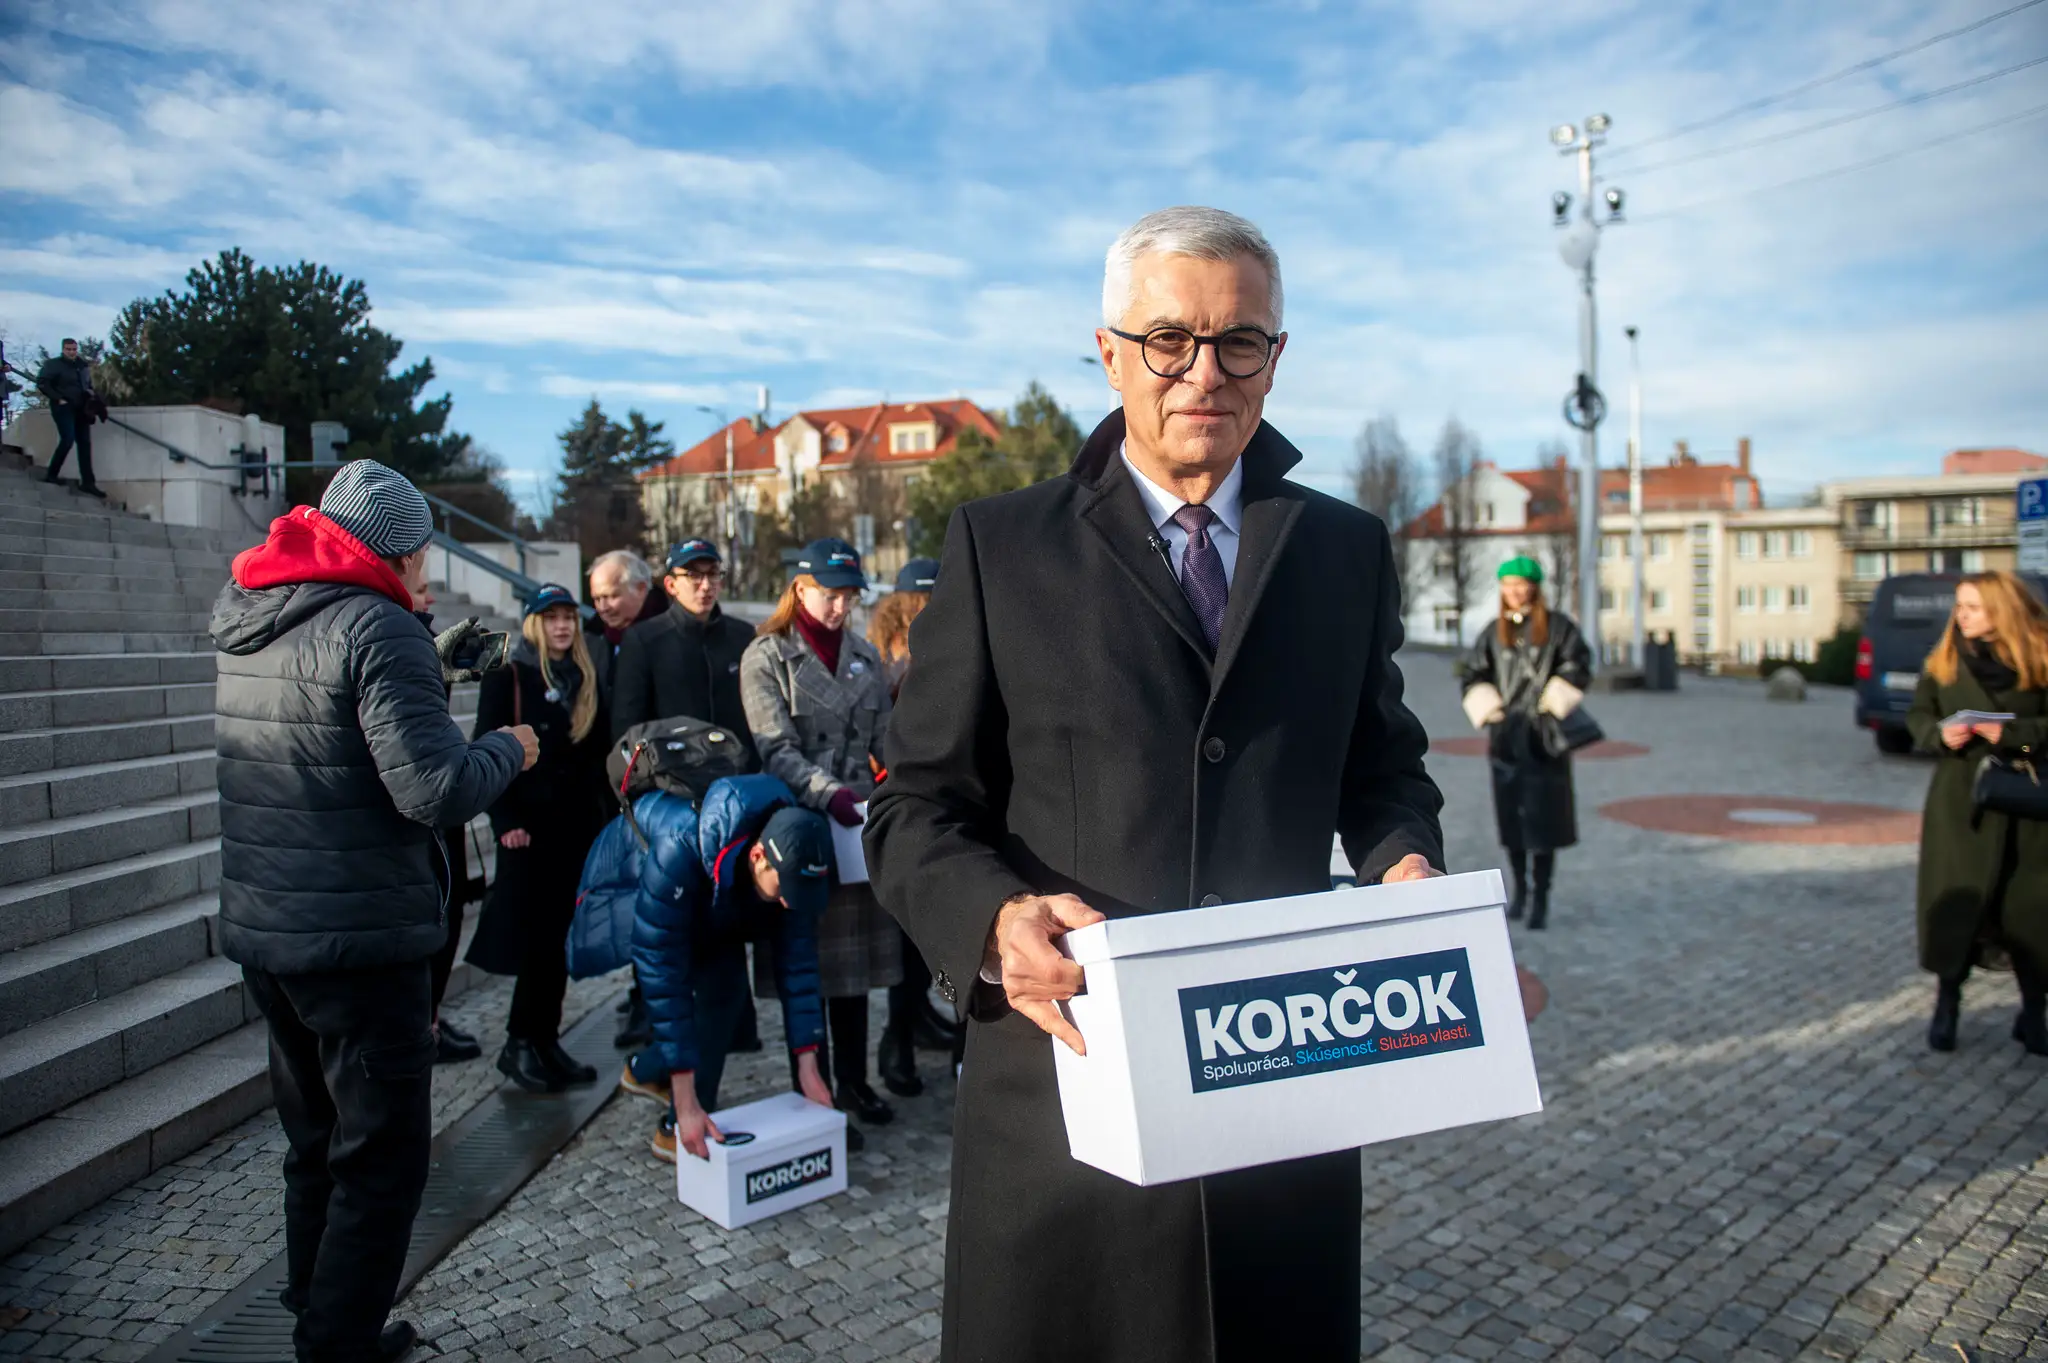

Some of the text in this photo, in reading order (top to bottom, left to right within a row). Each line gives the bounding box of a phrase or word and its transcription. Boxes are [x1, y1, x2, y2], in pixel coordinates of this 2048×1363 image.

[1195, 968, 1466, 1060] KORČOK
[1203, 1024, 1471, 1081] Spolupráca. Skúsenosť. Služba vlasti.
[749, 1153, 829, 1195] KORČOK
